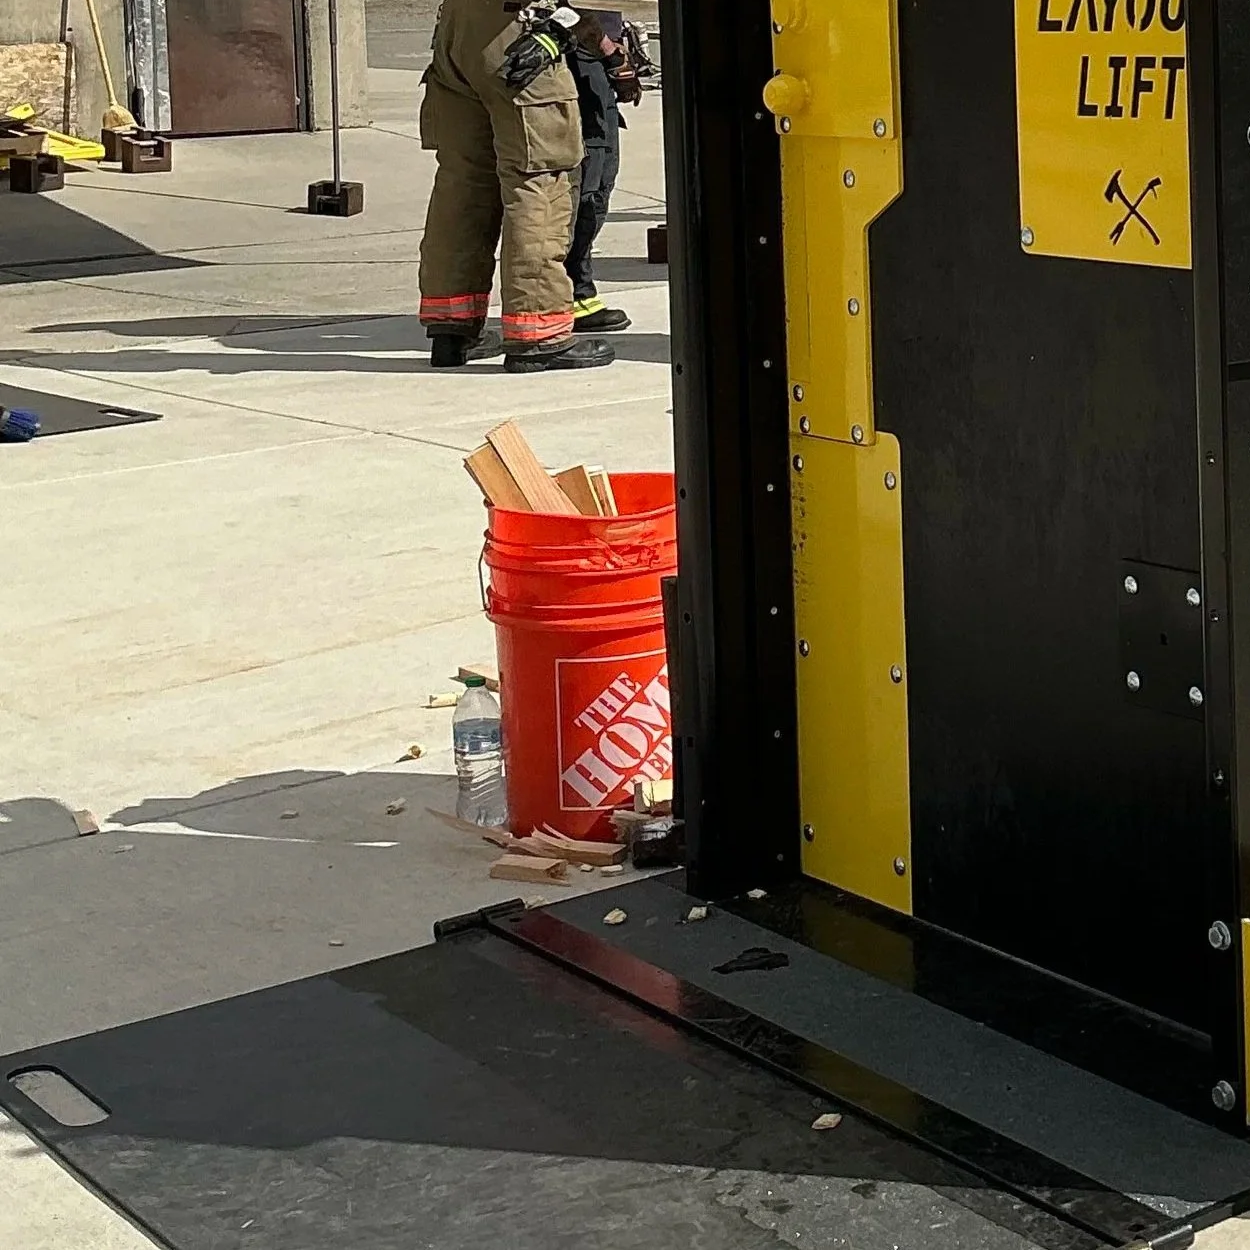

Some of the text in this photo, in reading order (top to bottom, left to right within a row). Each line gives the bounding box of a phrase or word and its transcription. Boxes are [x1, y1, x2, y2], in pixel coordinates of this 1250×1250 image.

[1077, 55, 1186, 119] LIFT
[573, 671, 643, 735] THE
[561, 663, 671, 808] HOM
[621, 734, 673, 796] DEP
